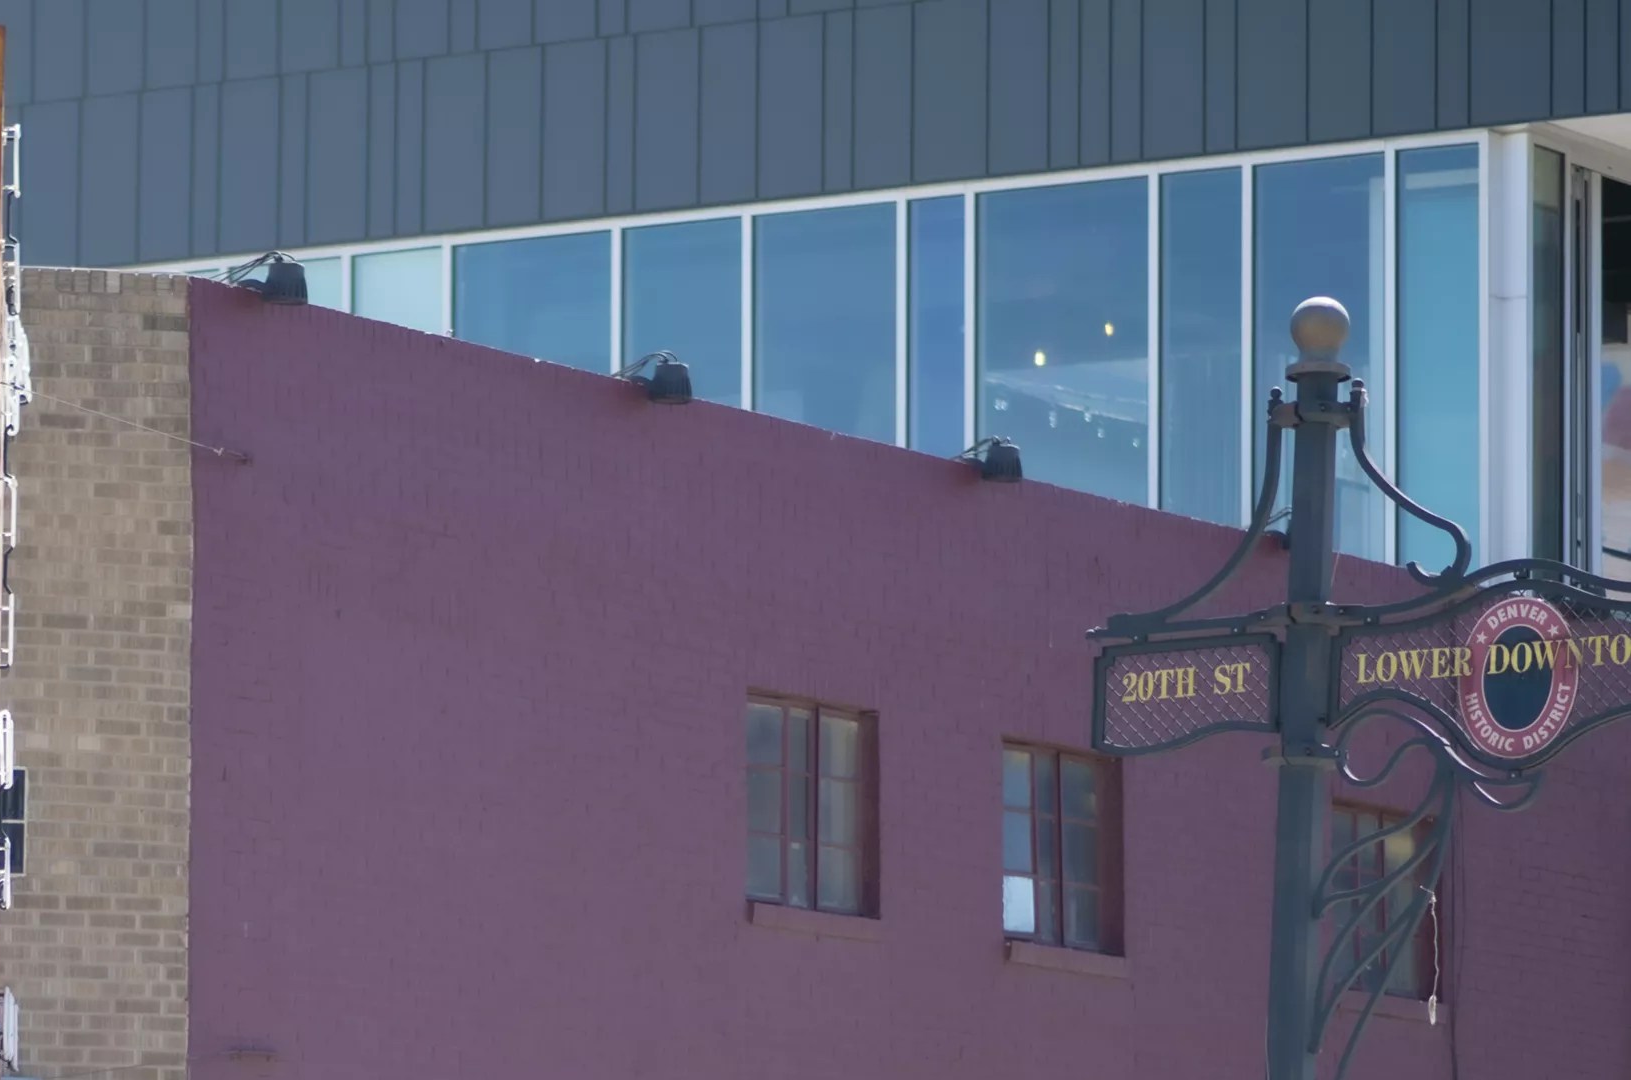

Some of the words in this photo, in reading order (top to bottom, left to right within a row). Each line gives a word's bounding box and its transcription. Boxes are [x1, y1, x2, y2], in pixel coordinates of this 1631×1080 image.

[1486, 602, 1548, 629] DENVER
[1121, 666, 1198, 704] 20TH
[1212, 663, 1252, 695] ST
[1355, 647, 1473, 685] LOWER
[1464, 691, 1517, 752] HISTORIC
[1522, 682, 1572, 751] DISTRICT
